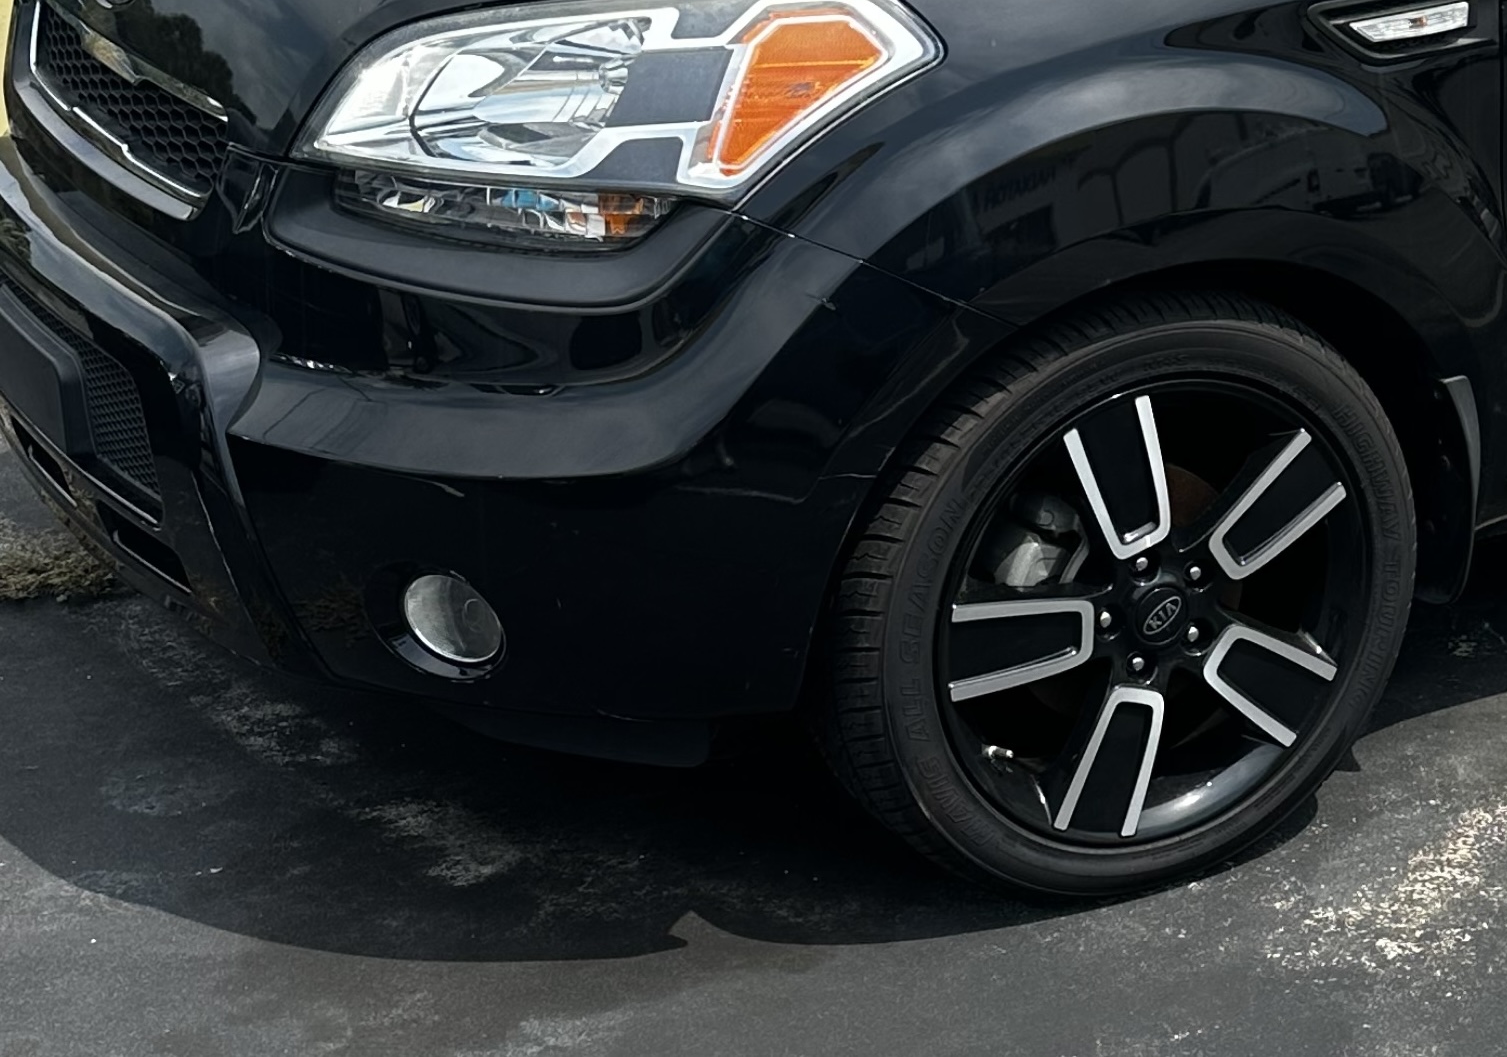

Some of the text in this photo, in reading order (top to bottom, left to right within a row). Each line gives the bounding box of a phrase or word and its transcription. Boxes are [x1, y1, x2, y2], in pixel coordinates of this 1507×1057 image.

[898, 497, 970, 664] SEASON
[1332, 403, 1403, 709] HIGHWAY TOURING
[1148, 602, 1178, 630] KIA
[899, 677, 931, 743] ALL
